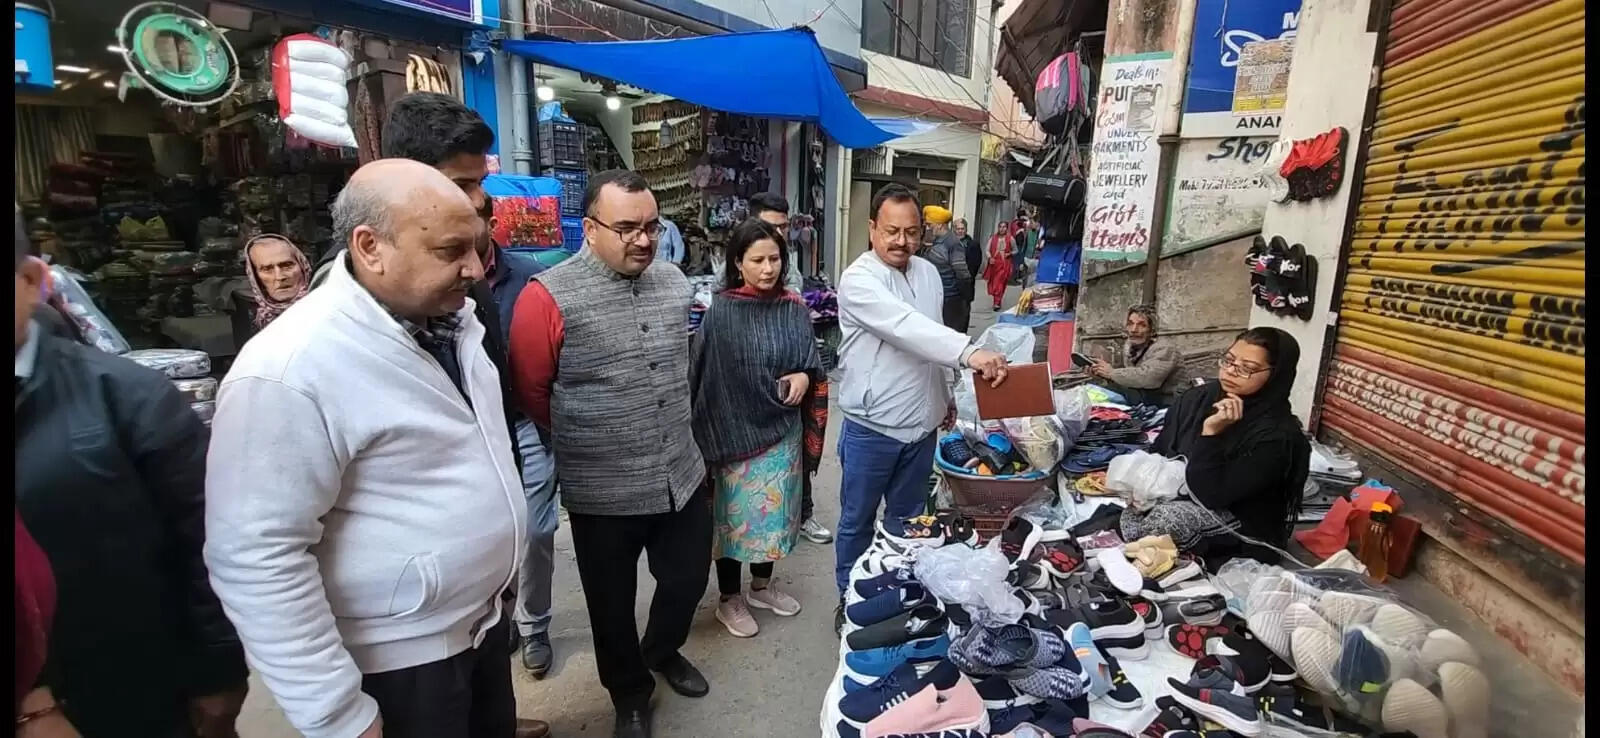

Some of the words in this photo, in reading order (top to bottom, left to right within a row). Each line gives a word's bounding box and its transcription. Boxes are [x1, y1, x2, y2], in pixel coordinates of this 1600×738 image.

[1115, 64, 1143, 81] Deals
[1107, 128, 1140, 139] UNDER
[1093, 136, 1152, 155] GARMENTS
[1103, 189, 1126, 200] and
[1091, 203, 1137, 225] Gift
[1090, 224, 1147, 249] Items
